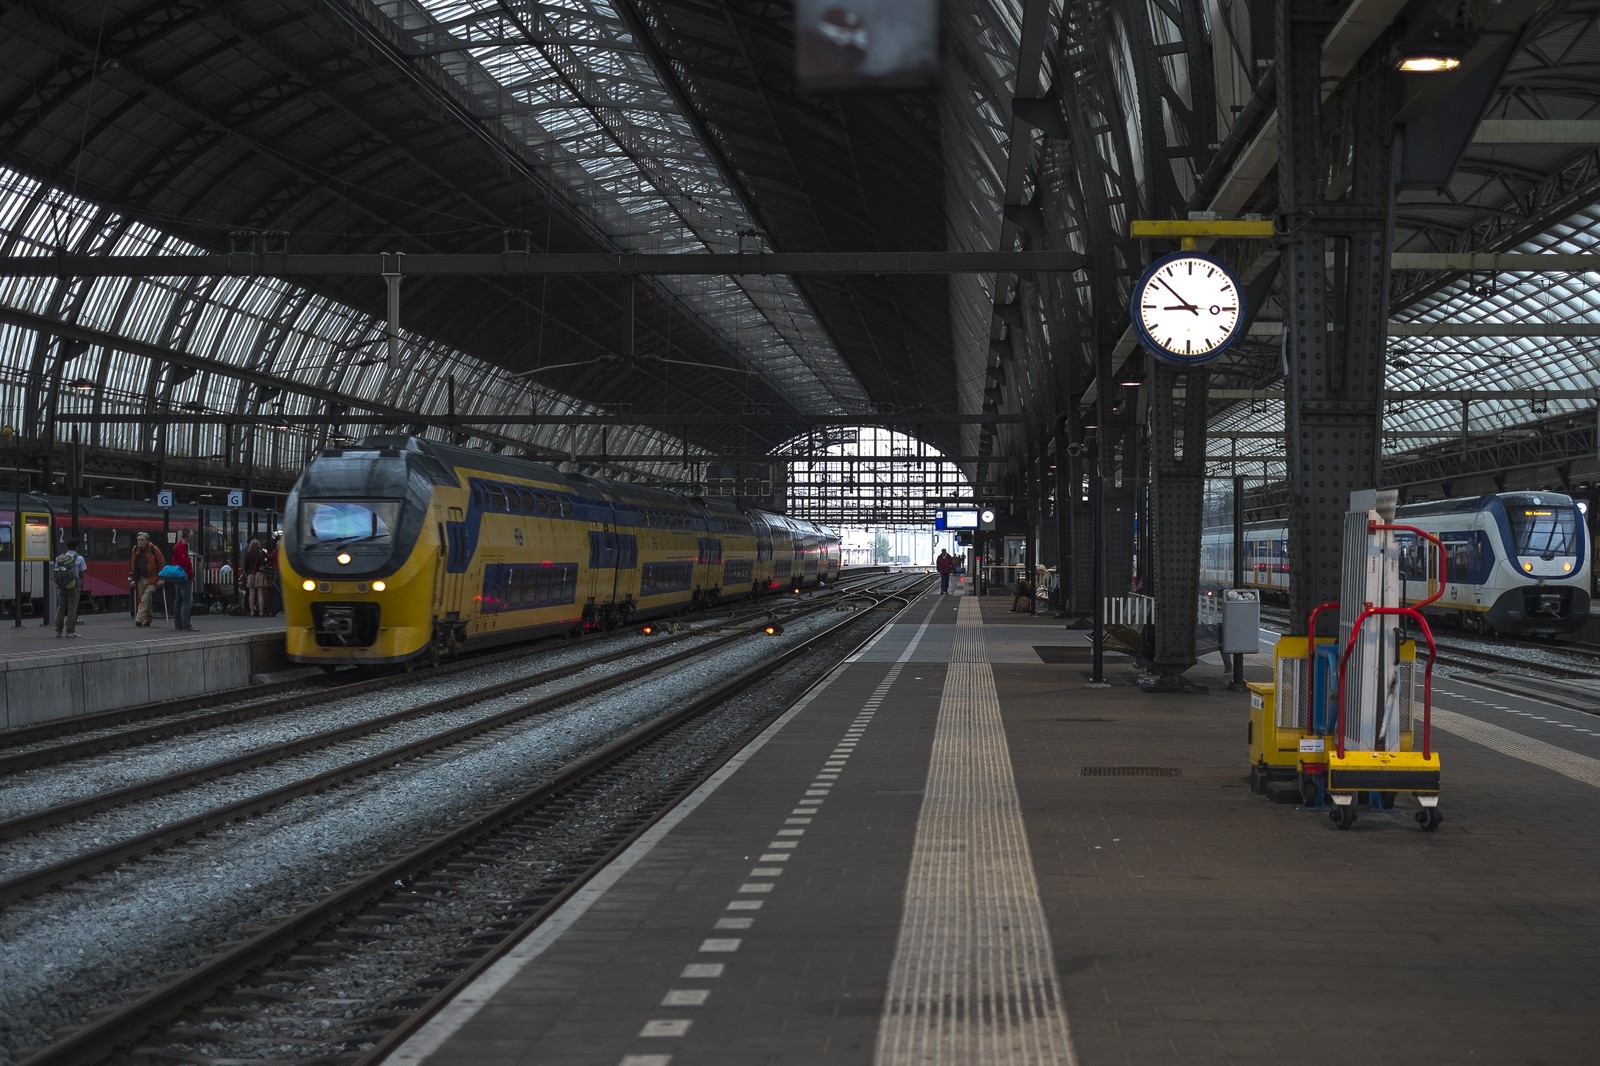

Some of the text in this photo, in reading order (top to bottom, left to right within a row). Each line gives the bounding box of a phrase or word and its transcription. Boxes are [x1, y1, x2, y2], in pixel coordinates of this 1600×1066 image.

[160, 495, 169, 505] G
[231, 495, 239, 505] G
[60, 527, 64, 543] 2
[112, 528, 117, 544] 2
